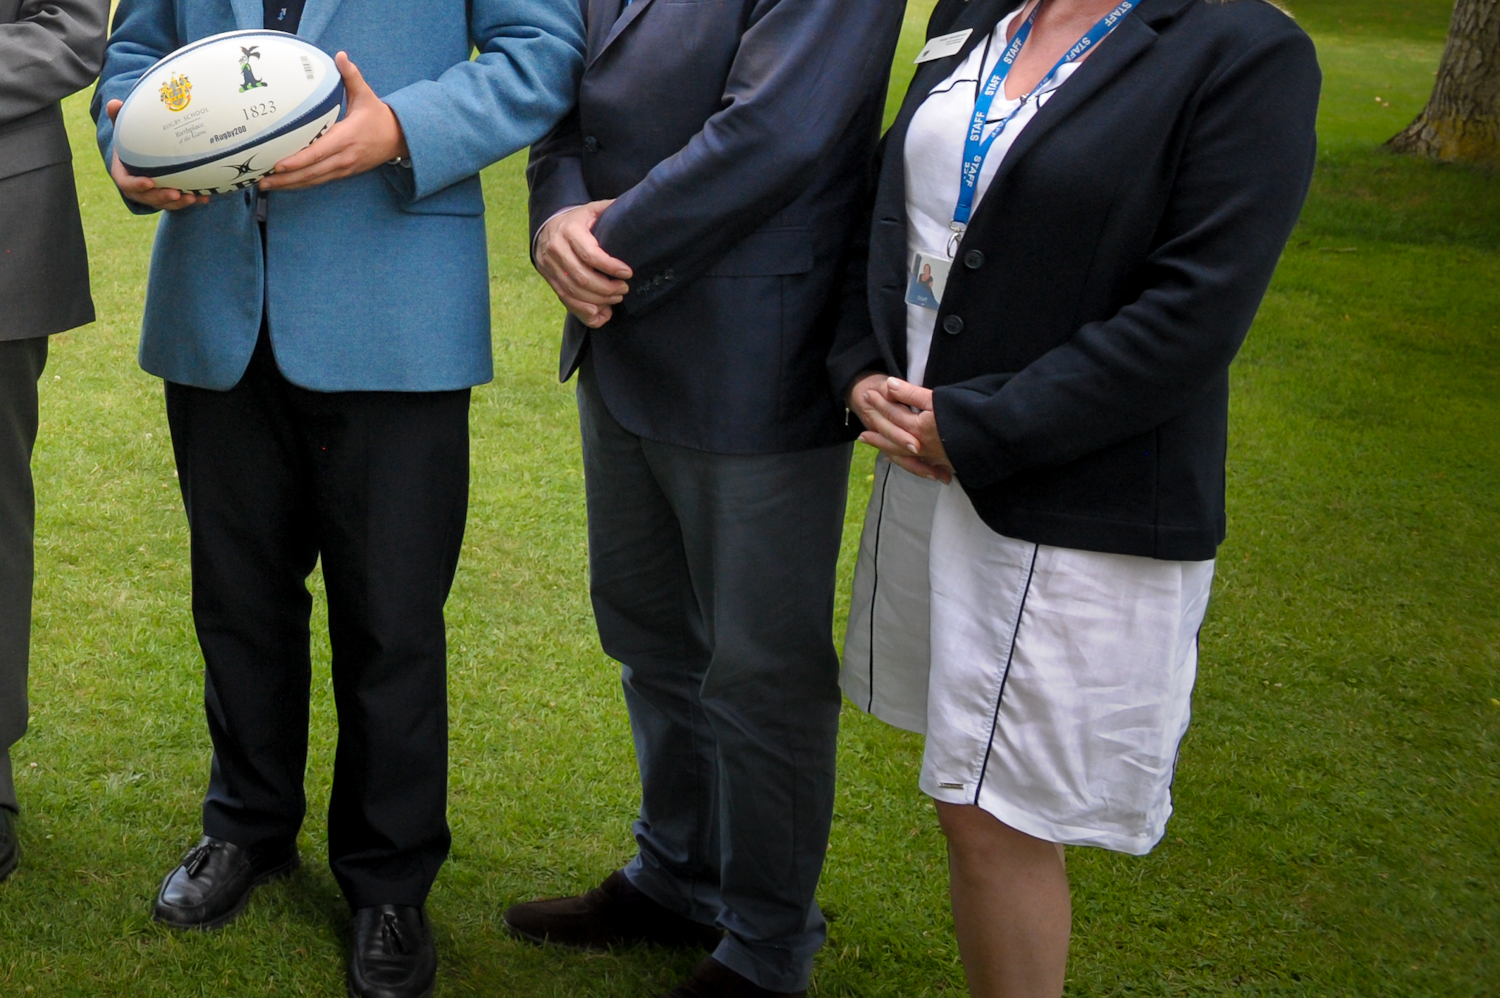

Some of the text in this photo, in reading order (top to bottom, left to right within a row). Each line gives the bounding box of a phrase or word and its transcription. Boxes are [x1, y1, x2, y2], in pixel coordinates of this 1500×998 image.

[1104, 1, 1132, 27] STAFF
[1003, 37, 1022, 64] STAFF
[1065, 37, 1091, 62] STAFF
[984, 74, 1001, 96] STAFF
[162, 107, 209, 131] RUGBY SCHOOL
[242, 100, 277, 121] 1823
[175, 123, 205, 139] Birthplace
[209, 125, 247, 144] #Rugby200
[970, 111, 985, 141] STAFF
[966, 155, 982, 187] STAFF
